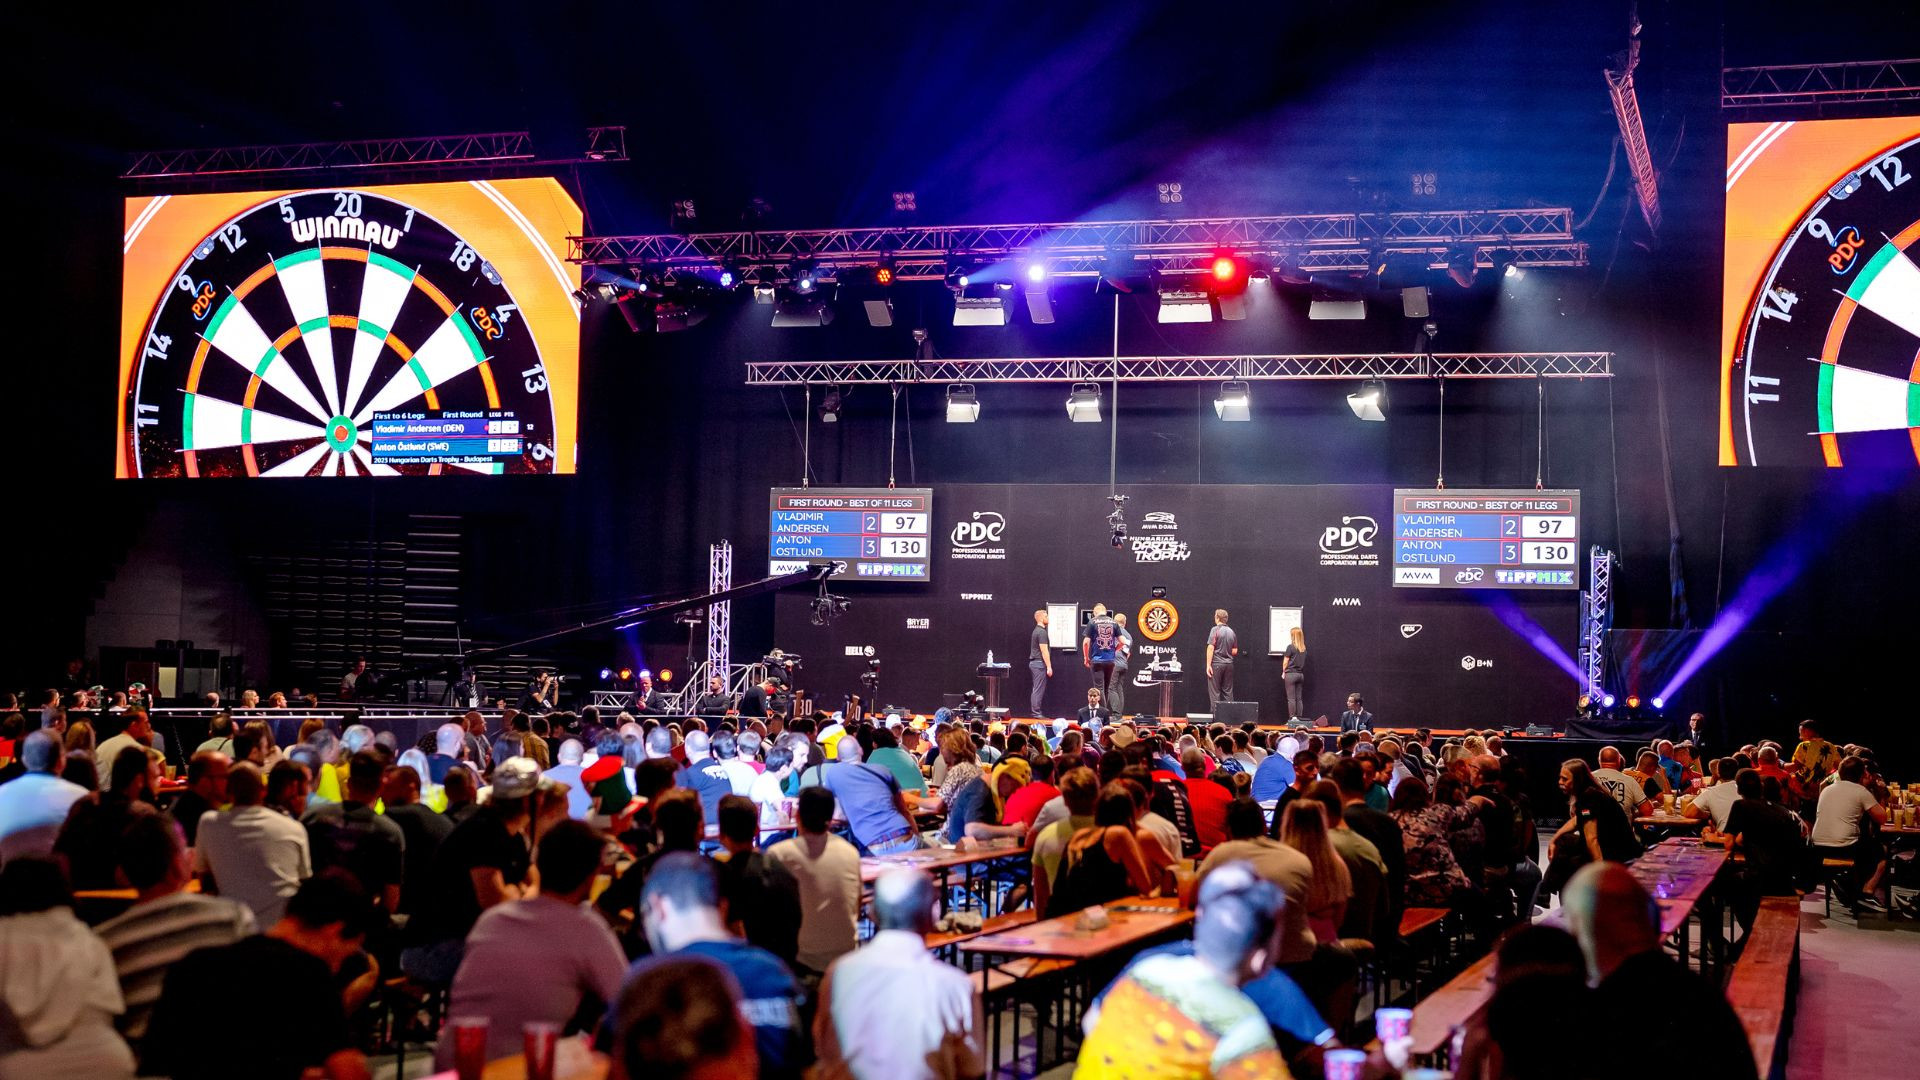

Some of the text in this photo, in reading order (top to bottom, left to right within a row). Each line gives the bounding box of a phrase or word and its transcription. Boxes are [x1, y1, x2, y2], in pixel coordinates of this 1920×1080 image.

[1869, 157, 1912, 192] 12
[279, 199, 296, 223] 5
[334, 192, 362, 217] 20
[404, 209, 415, 232] 1
[219, 224, 247, 253] 12
[291, 216, 400, 249] WINMAU
[1808, 218, 1837, 247] 9
[449, 240, 476, 272] 18
[1828, 231, 1864, 270] PDC
[178, 275, 198, 298] 9
[192, 285, 216, 317] PDC
[1762, 288, 1798, 322] 14
[496, 303, 517, 323] 4
[474, 306, 499, 340] PDC
[147, 333, 172, 360] 14
[522, 364, 547, 394] 13
[1750, 375, 1780, 404] 11
[138, 404, 159, 427] 11
[375, 424, 465, 434] Vladimir Andersen (DEN)
[375, 441, 449, 452] Anton Östlund (SWE)
[438, 456, 460, 464] Trophy
[464, 456, 492, 464] Budapest
[789, 499, 812, 507] FIRST
[1416, 501, 1441, 509] FIRST
[1443, 501, 1478, 510] ROUND
[1485, 501, 1508, 510] BEST
[1510, 501, 1523, 510] OF
[1525, 502, 1533, 510] 11
[1534, 502, 1557, 510] LEGS
[777, 513, 824, 521] VLADIMIR
[866, 517, 876, 530] 2
[896, 517, 916, 530] 97
[1402, 516, 1456, 524] VLADIMIR
[777, 525, 829, 533] ANDERSEN
[957, 522, 1001, 541] PDC
[1402, 529, 1463, 537] ANDERSEN
[1505, 520, 1516, 535] 2
[1539, 520, 1562, 534] 97
[776, 536, 811, 544] ANTON
[1326, 527, 1373, 546] PDC
[776, 548, 822, 556] OSTLUND
[866, 540, 875, 554] 3
[891, 541, 921, 554] 130
[1132, 541, 1178, 550] DARTS
[1402, 541, 1442, 549] ANTON
[1134, 550, 1191, 561] TROPHY
[1402, 553, 1456, 562] OSTLUND
[1505, 545, 1516, 560] 3
[1534, 546, 1568, 560] 130
[1458, 571, 1482, 581] PDC
[1332, 598, 1361, 606] MVM
[1476, 659, 1493, 668] B+N
